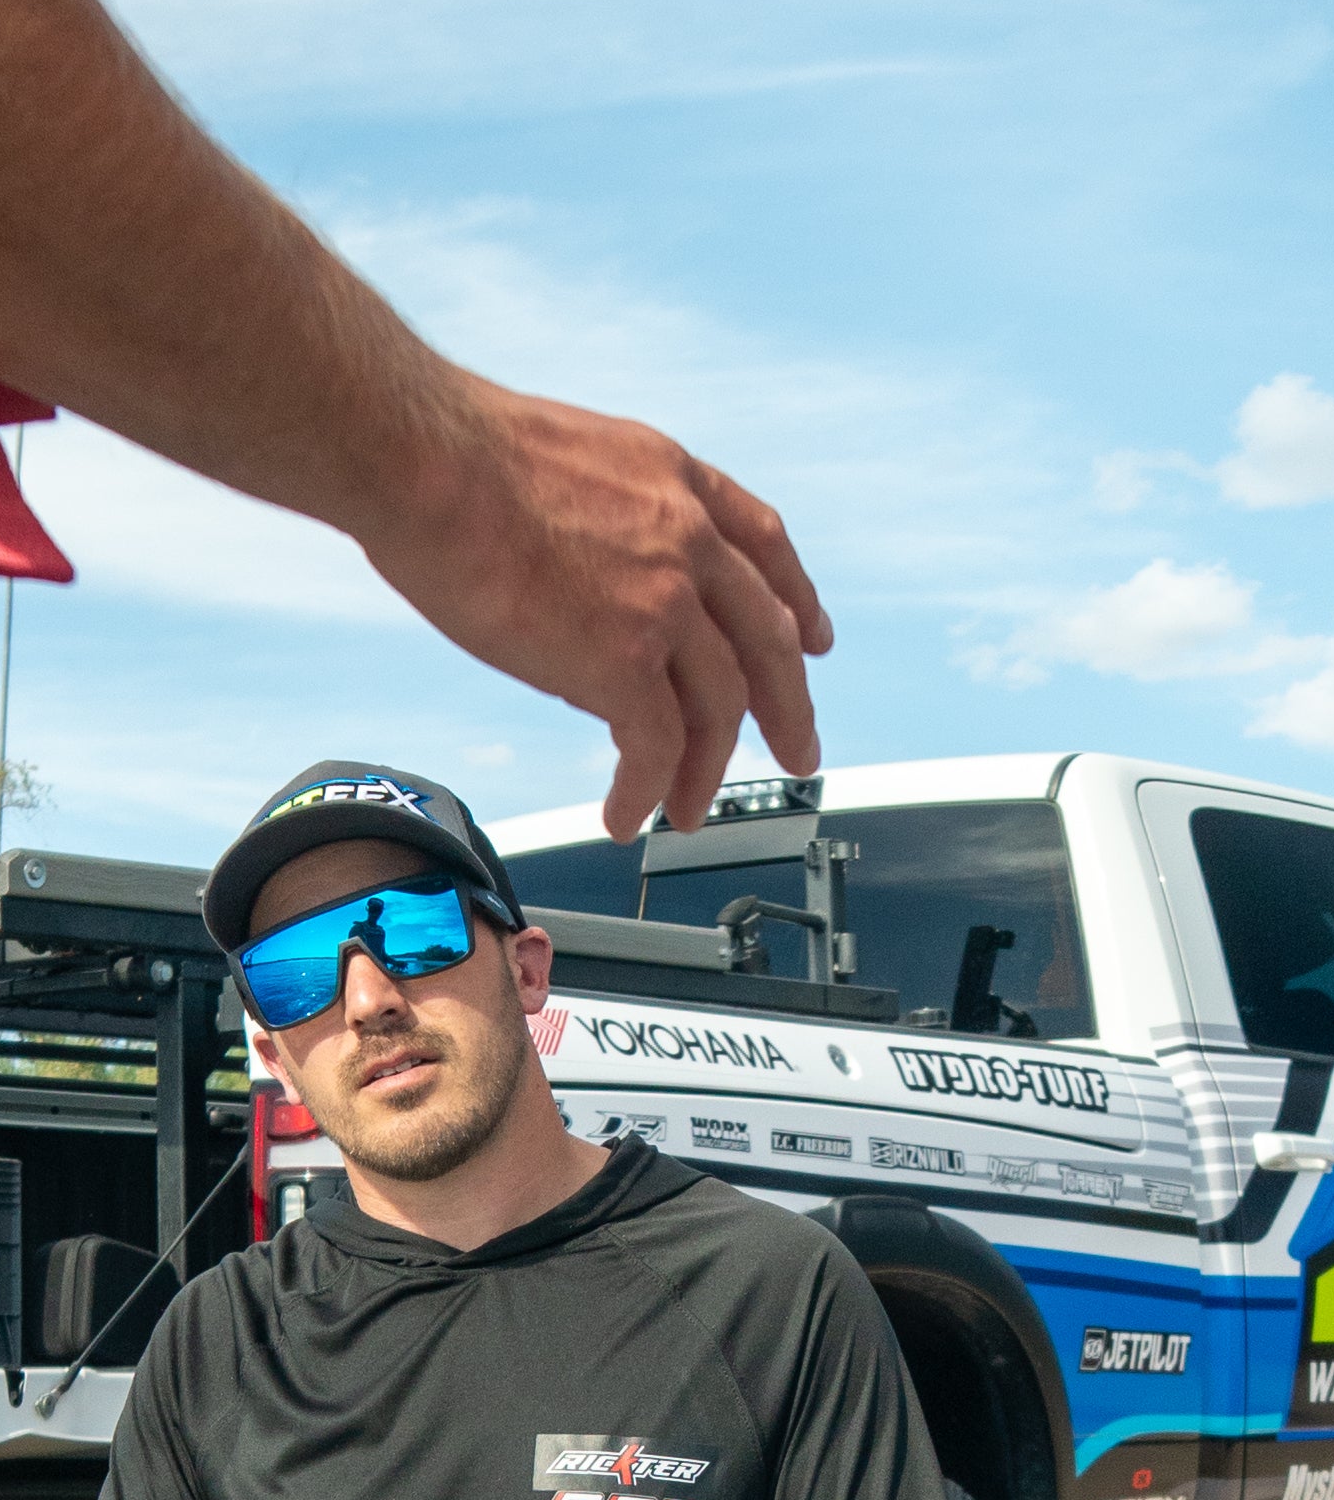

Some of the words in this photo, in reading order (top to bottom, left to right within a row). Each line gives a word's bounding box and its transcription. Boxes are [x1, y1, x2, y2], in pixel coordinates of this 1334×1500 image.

[574, 1015, 795, 1072] YOKOHAMA
[888, 1046, 1109, 1113] HYDRO-TURF
[1102, 1331, 1192, 1373] JETPILOT
[546, 1443, 711, 1487] RICKTER
